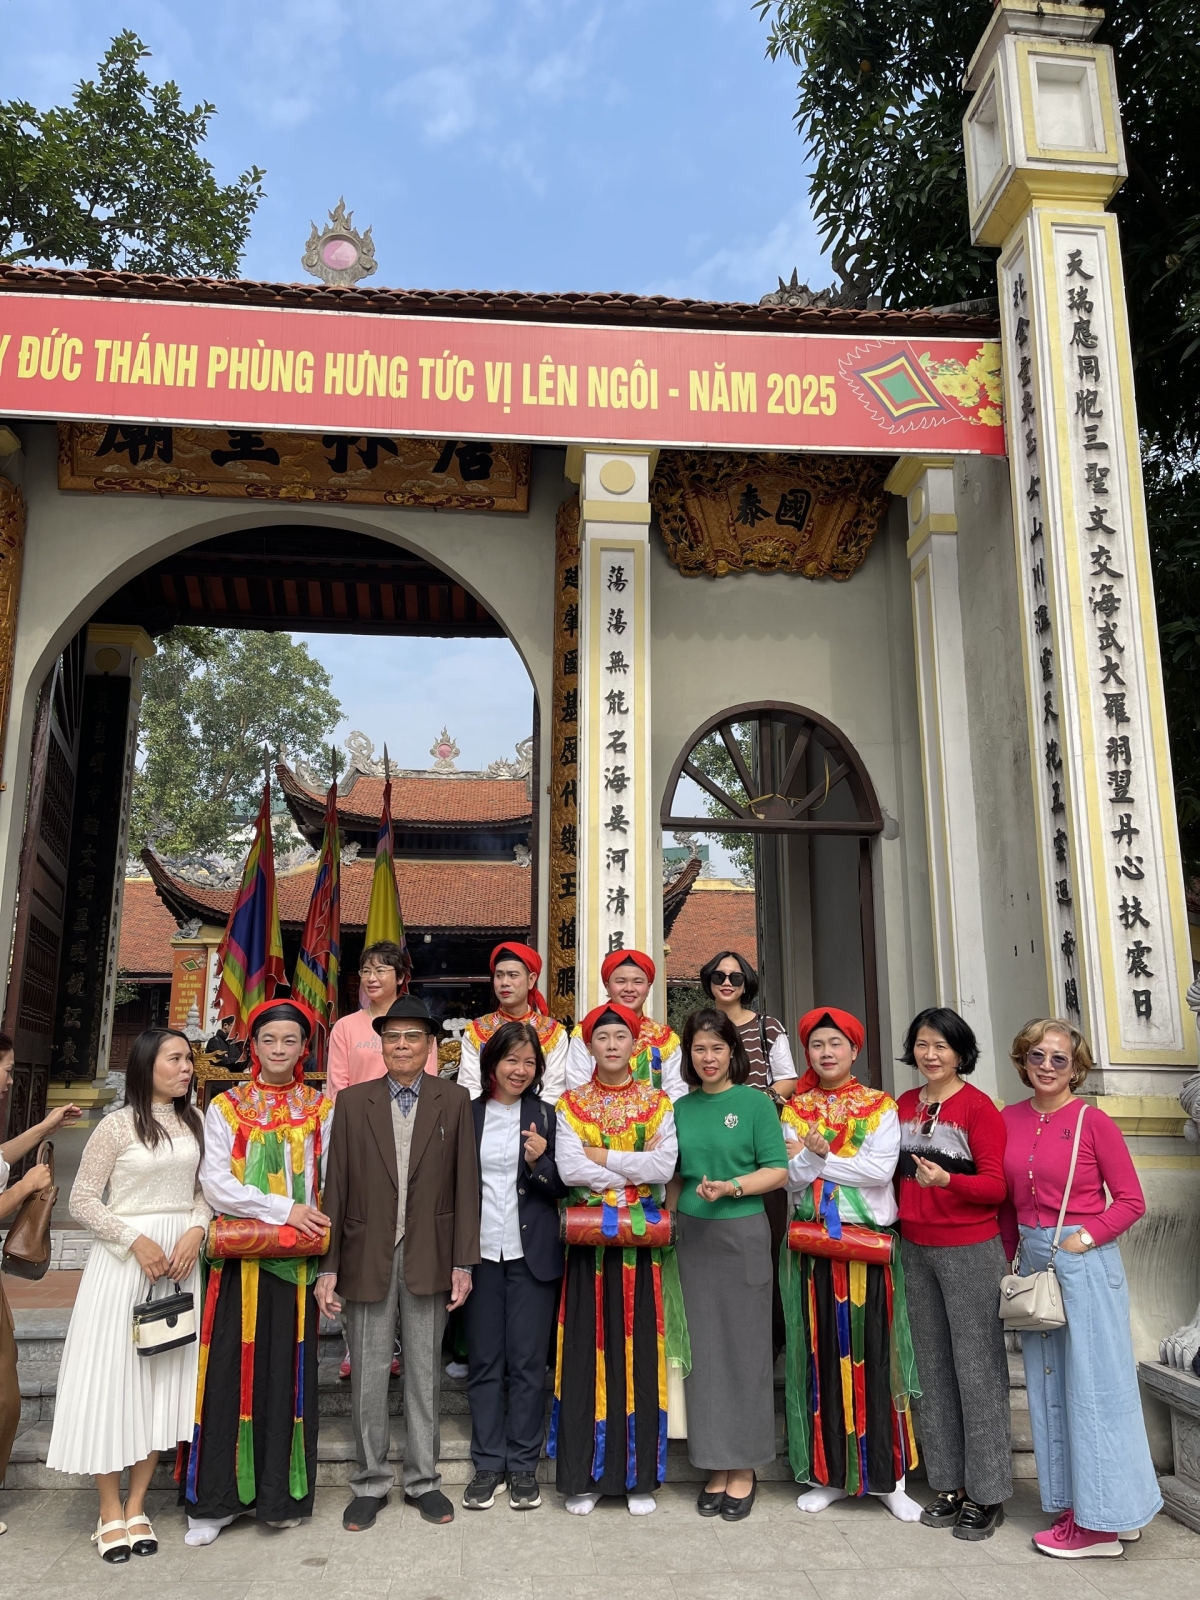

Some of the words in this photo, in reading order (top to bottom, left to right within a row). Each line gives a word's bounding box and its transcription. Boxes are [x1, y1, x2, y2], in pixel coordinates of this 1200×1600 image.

[18, 328, 83, 381] ĐỨC
[95, 333, 198, 387] THÁNH
[207, 340, 314, 393] PHÙNG
[324, 350, 408, 398] HƯNG
[419, 349, 474, 402] TỨC
[485, 362, 511, 413] VỊ
[523, 355, 577, 406] LÊN
[588, 359, 658, 409] NGÔI
[690, 362, 757, 412] NĂM
[767, 373, 836, 416] 2025
